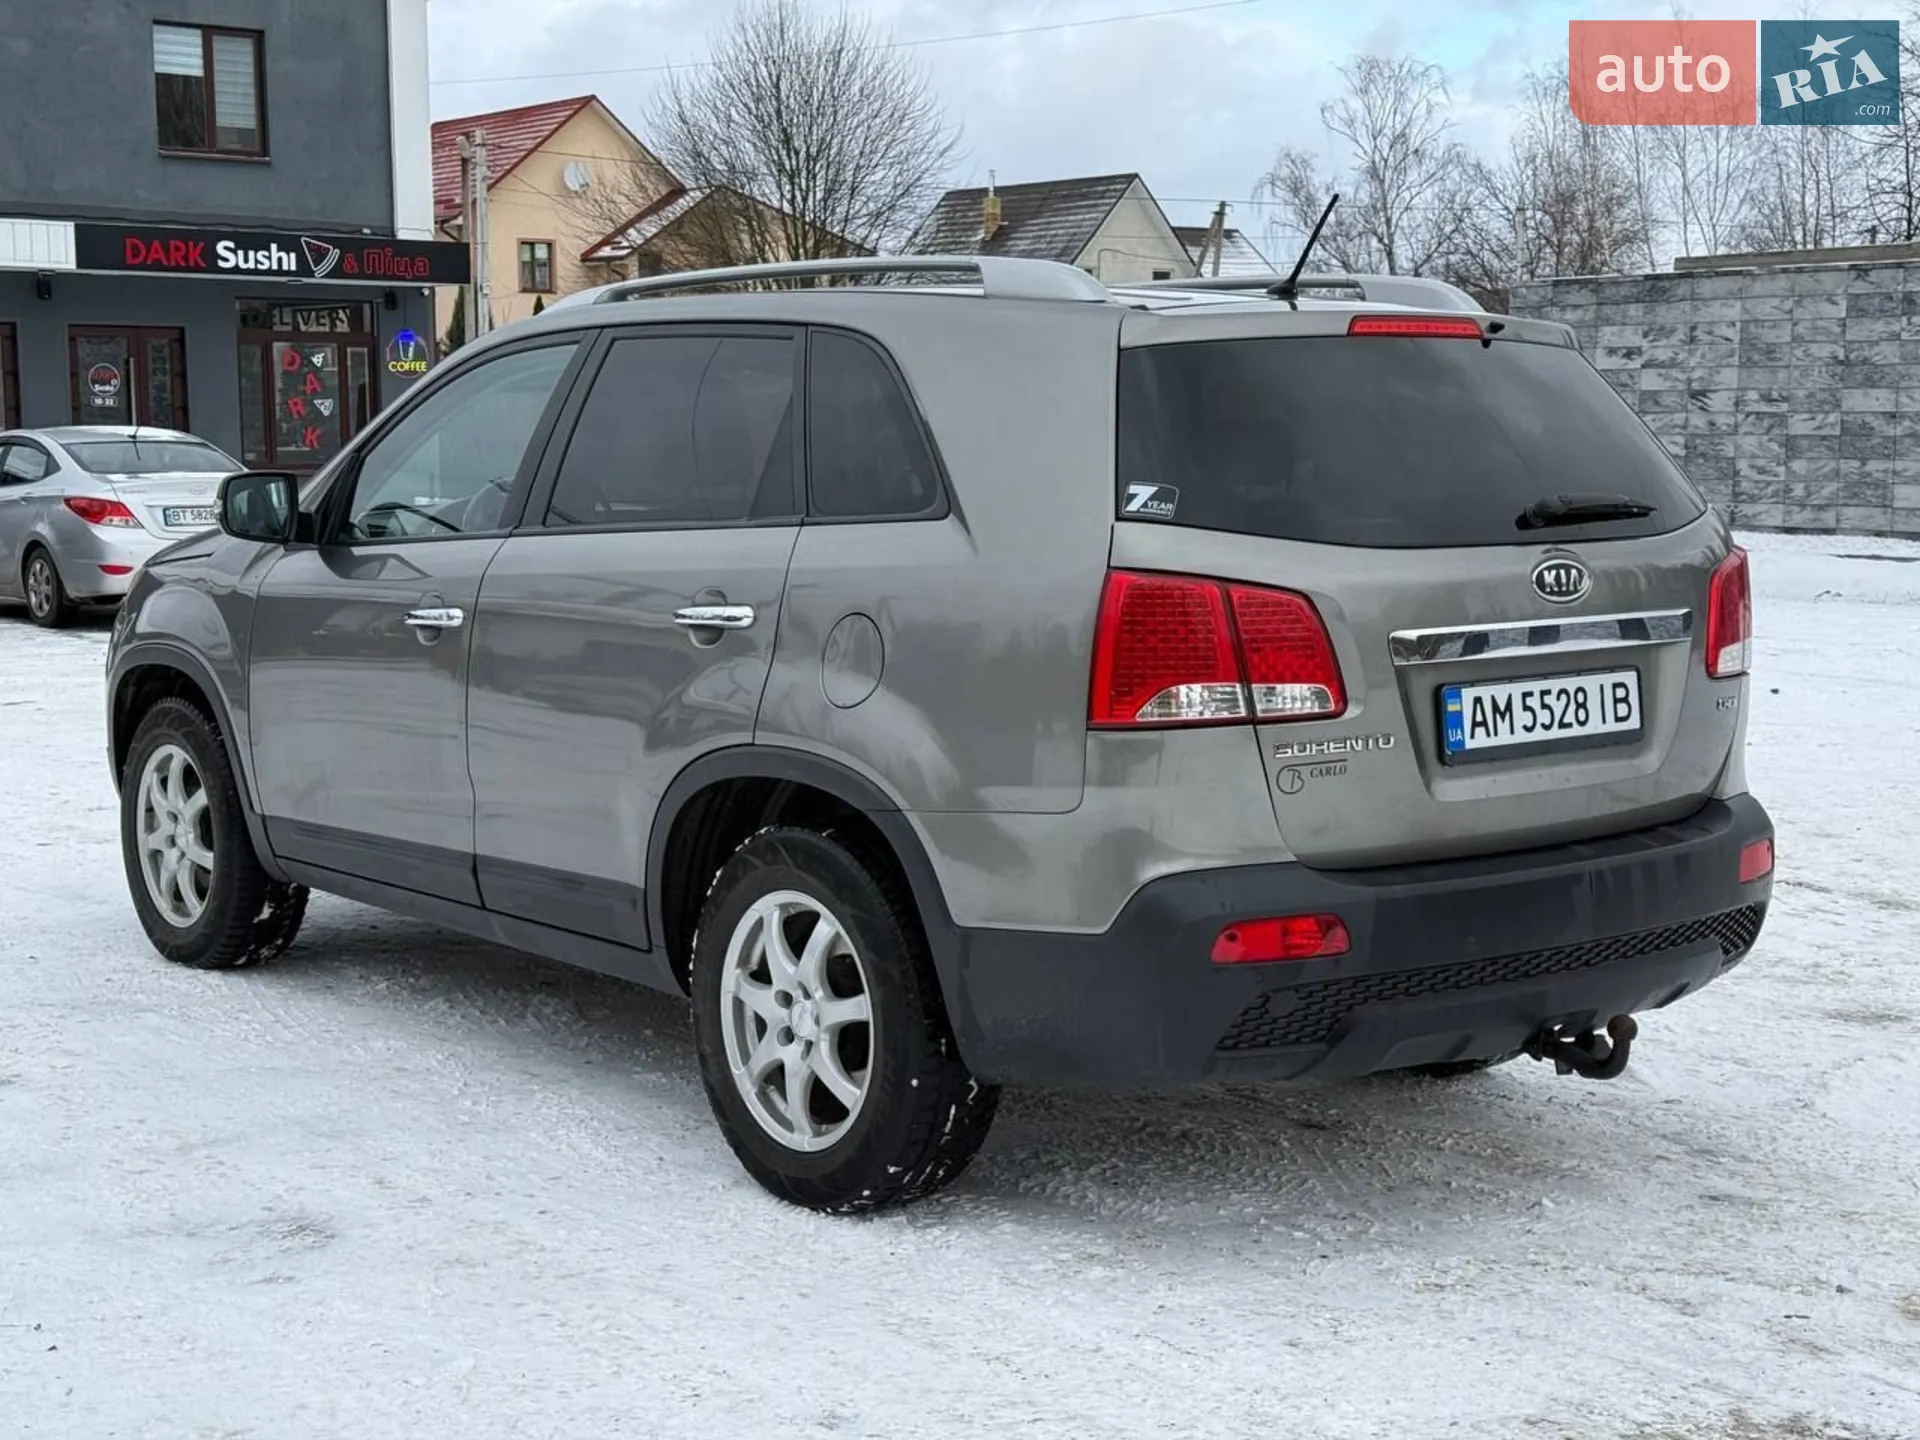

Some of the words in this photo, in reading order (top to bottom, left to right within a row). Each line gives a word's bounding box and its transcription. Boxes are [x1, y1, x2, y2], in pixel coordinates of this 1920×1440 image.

[125, 238, 206, 267] DARK
[216, 240, 297, 271] Sushi
[343, 253, 359, 273] &
[388, 361, 428, 372] COFFEE
[1125, 485, 1159, 511] 7
[1147, 500, 1174, 511] YEAR
[1542, 568, 1588, 592] KIA
[1521, 686, 1590, 733] 5528
[1274, 734, 1395, 758] SORENTO
[1449, 730, 1463, 742] UA
[1310, 764, 1347, 778] CARLO
